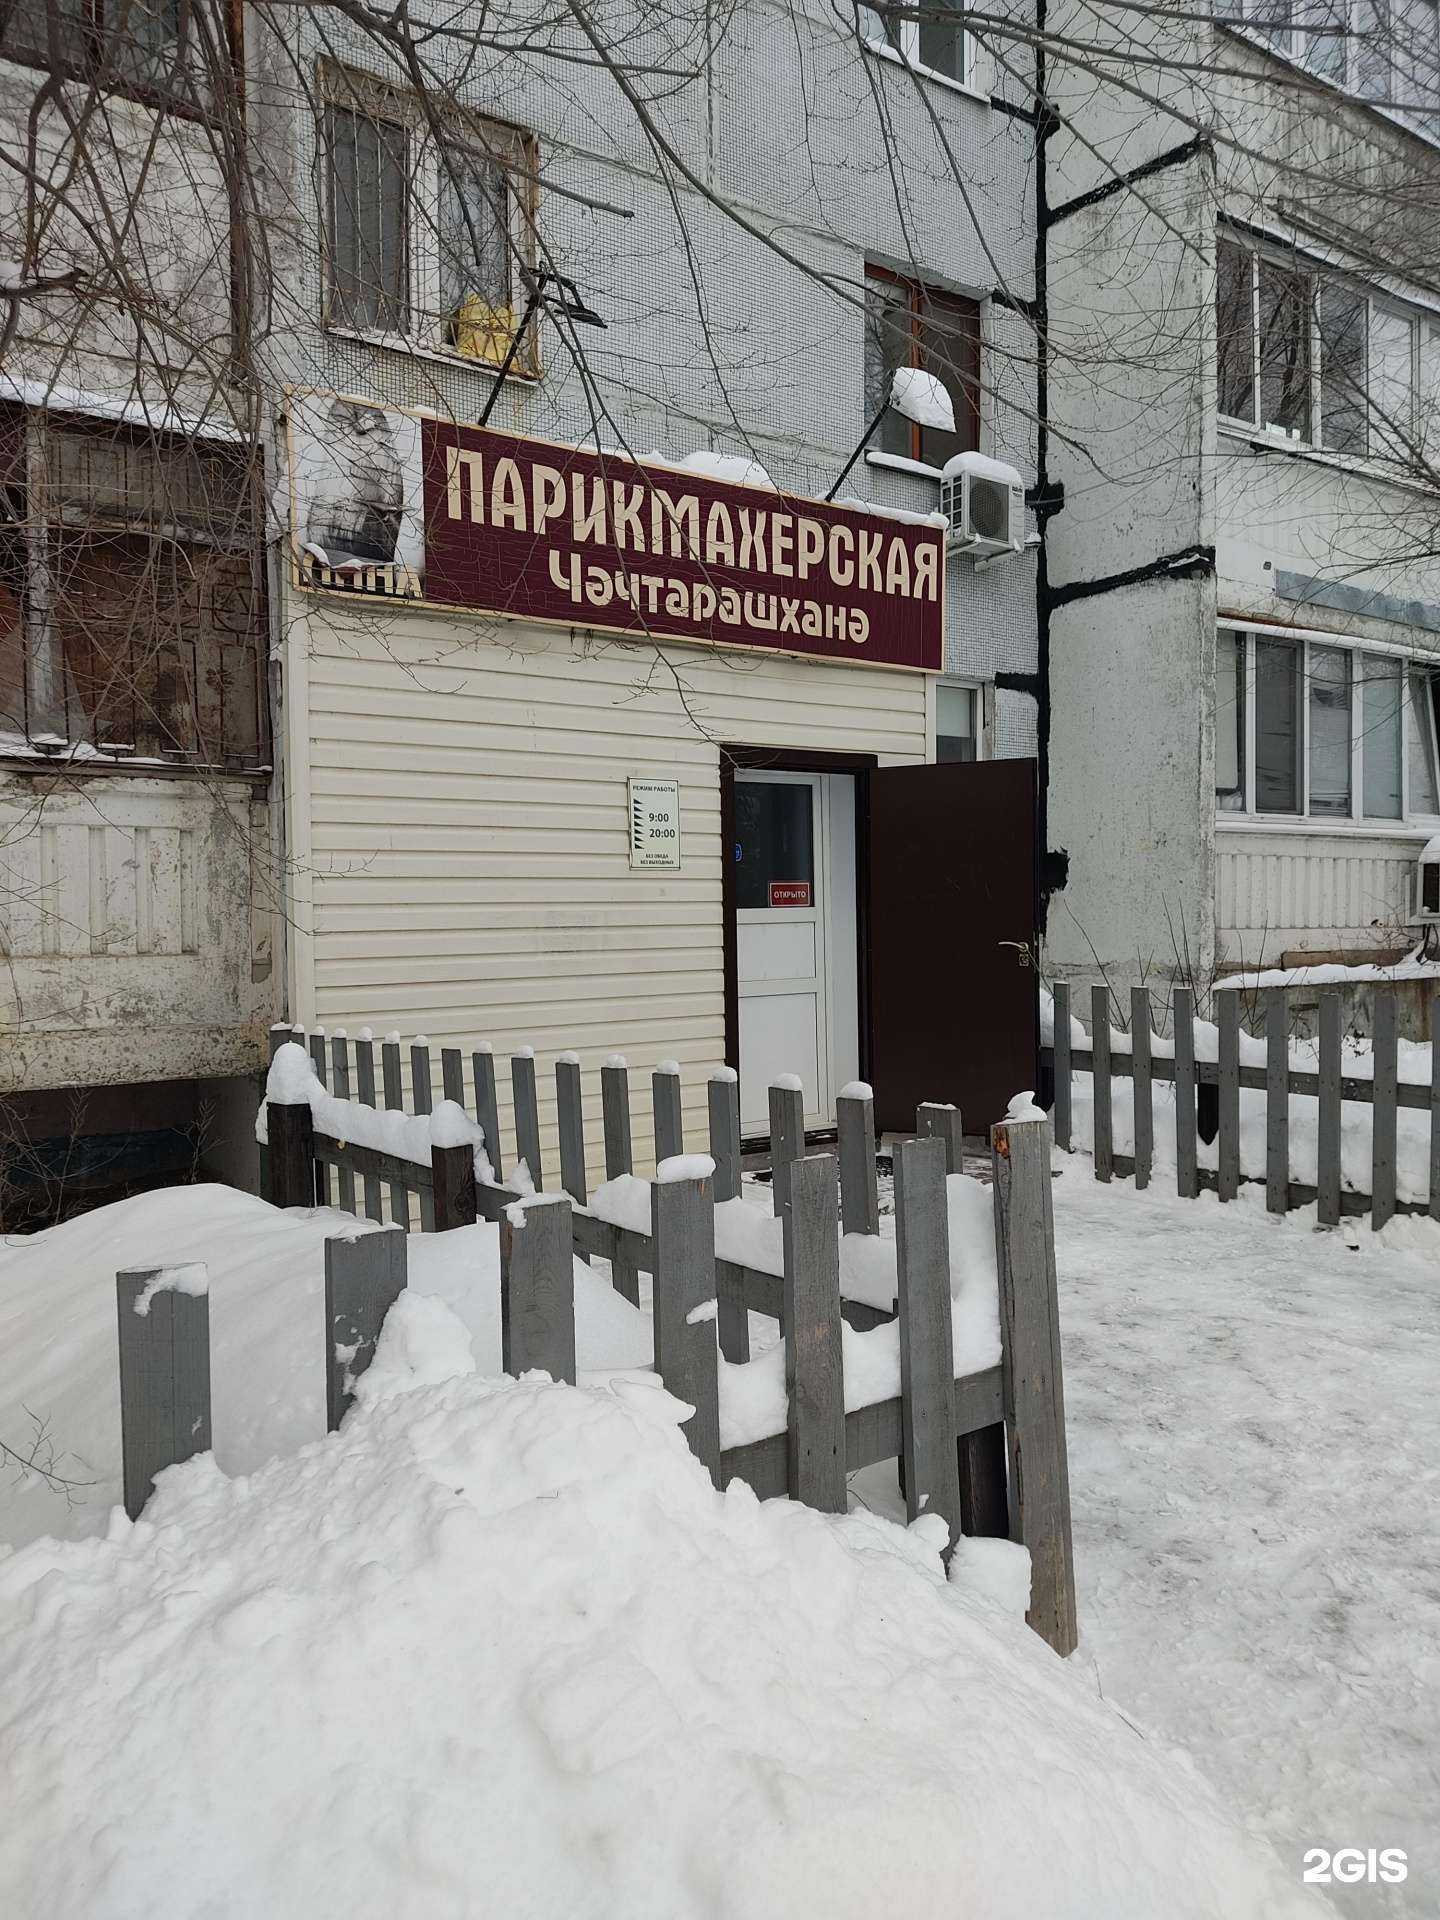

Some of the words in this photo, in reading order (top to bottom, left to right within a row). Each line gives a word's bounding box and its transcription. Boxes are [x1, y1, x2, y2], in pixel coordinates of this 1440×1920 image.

[446, 446, 938, 601] ПАРИКМАХЕРСКАЯ
[548, 549, 870, 644] Чәчтарашханә
[648, 812, 669, 823] 9:00
[649, 828, 676, 838] 20:00
[773, 890, 807, 899] ОТКРЫТО
